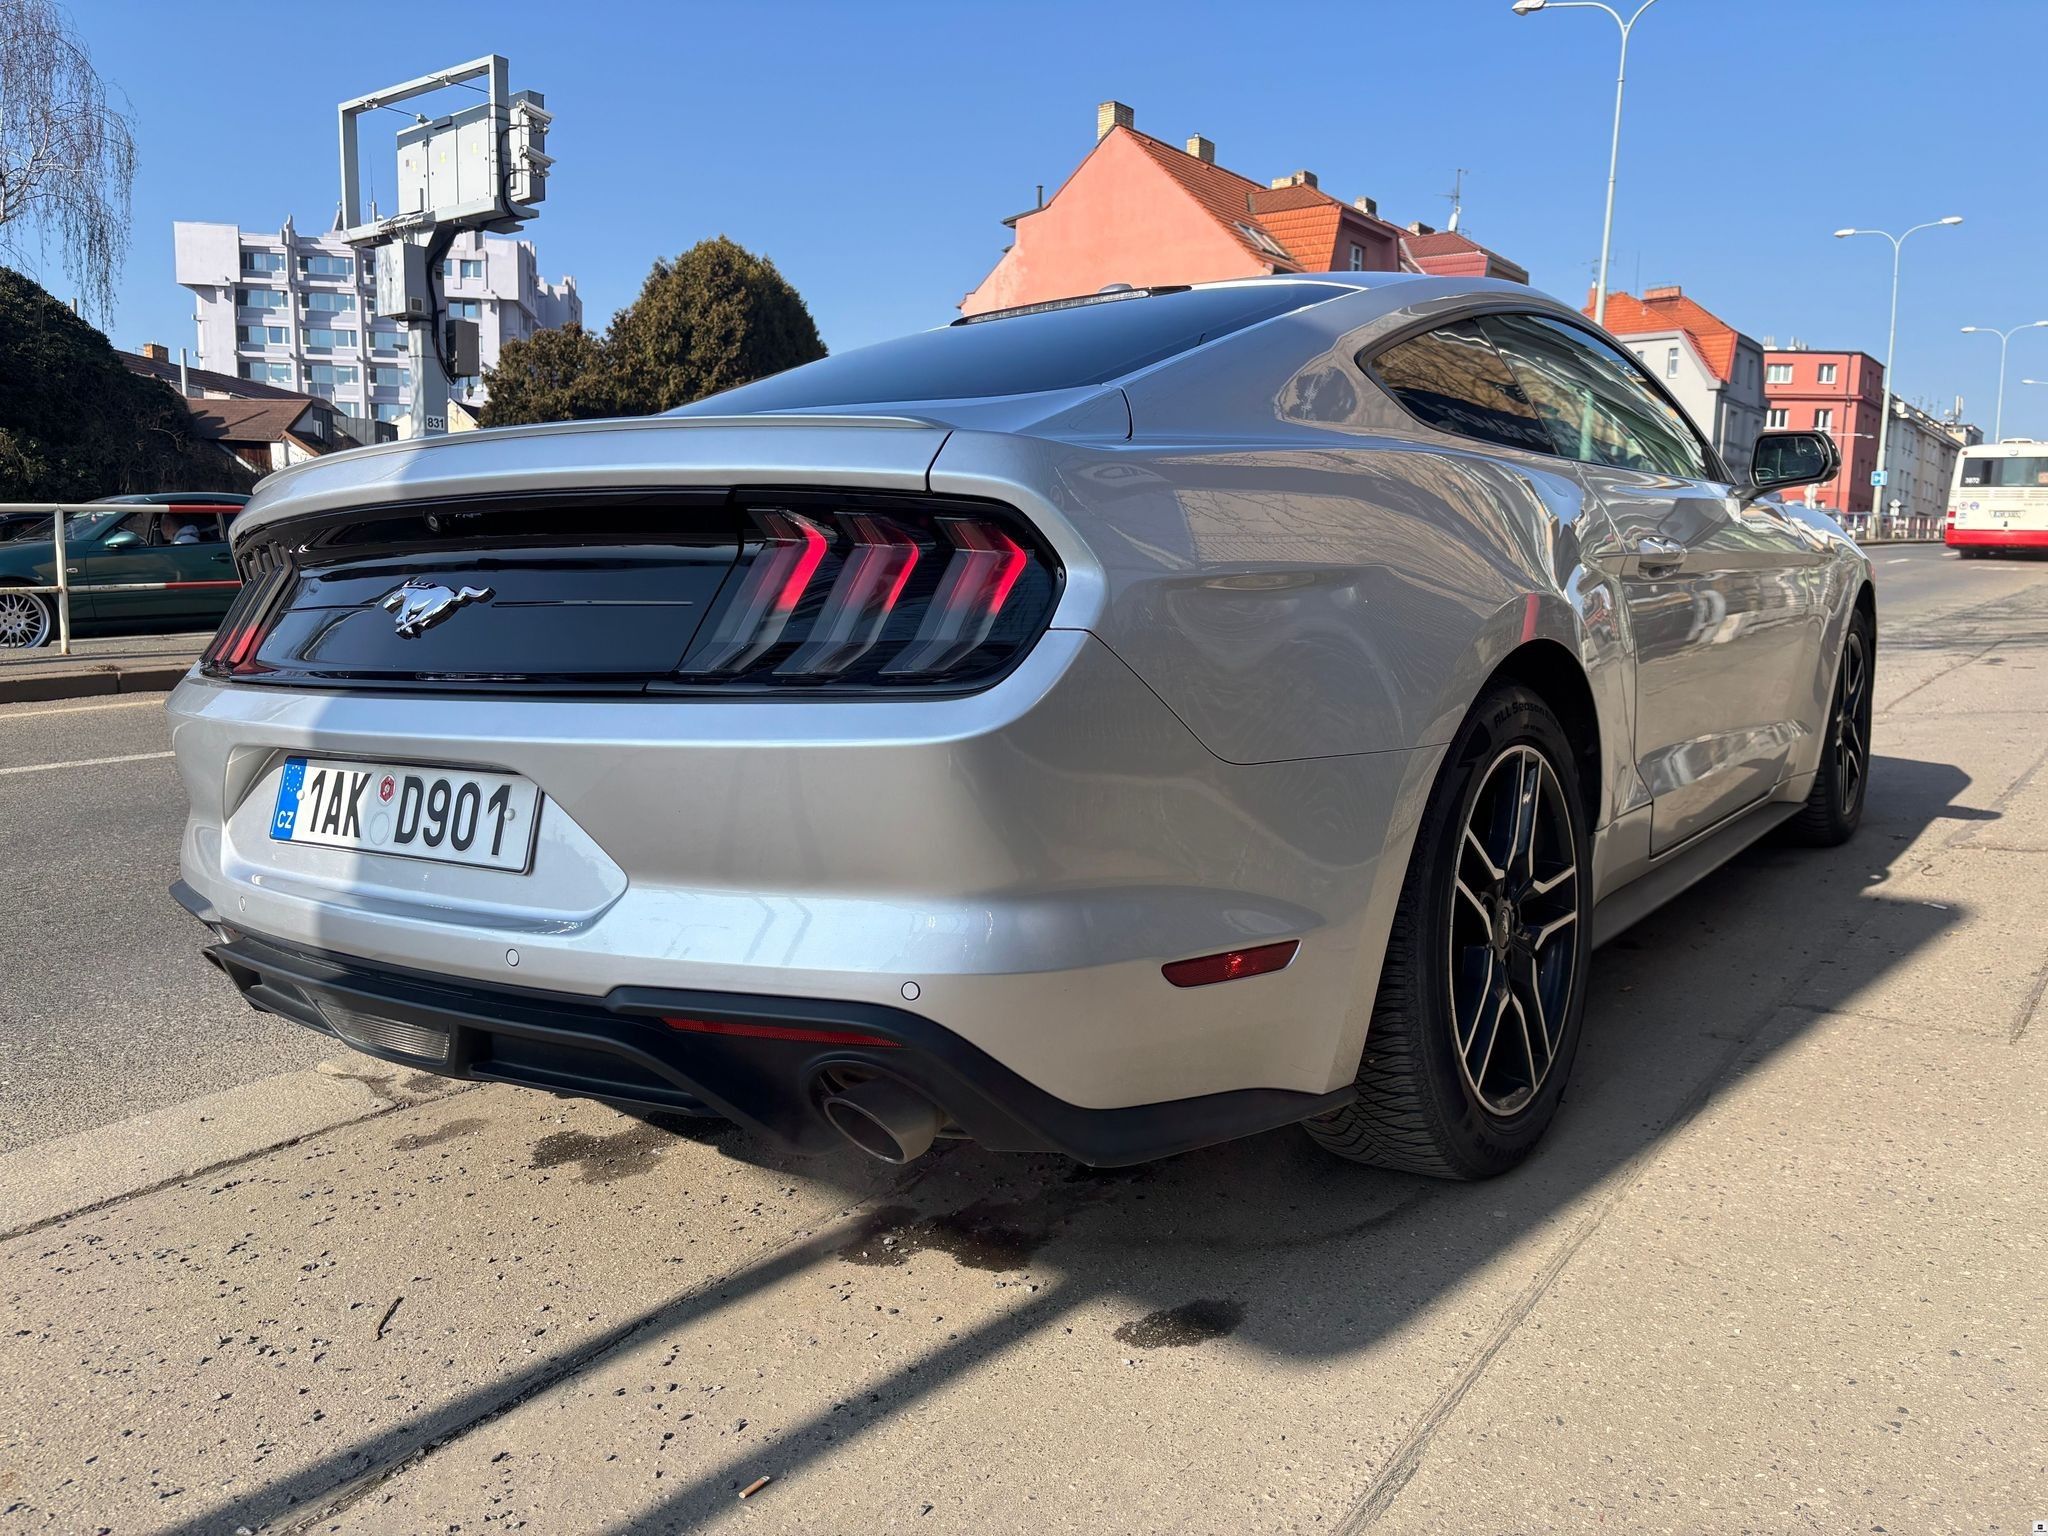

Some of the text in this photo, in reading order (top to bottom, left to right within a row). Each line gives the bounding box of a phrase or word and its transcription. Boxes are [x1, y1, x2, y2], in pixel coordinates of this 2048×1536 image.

[427, 417, 444, 429] 831
[276, 809, 293, 829] CZ
[309, 770, 513, 856] 1AK D901
